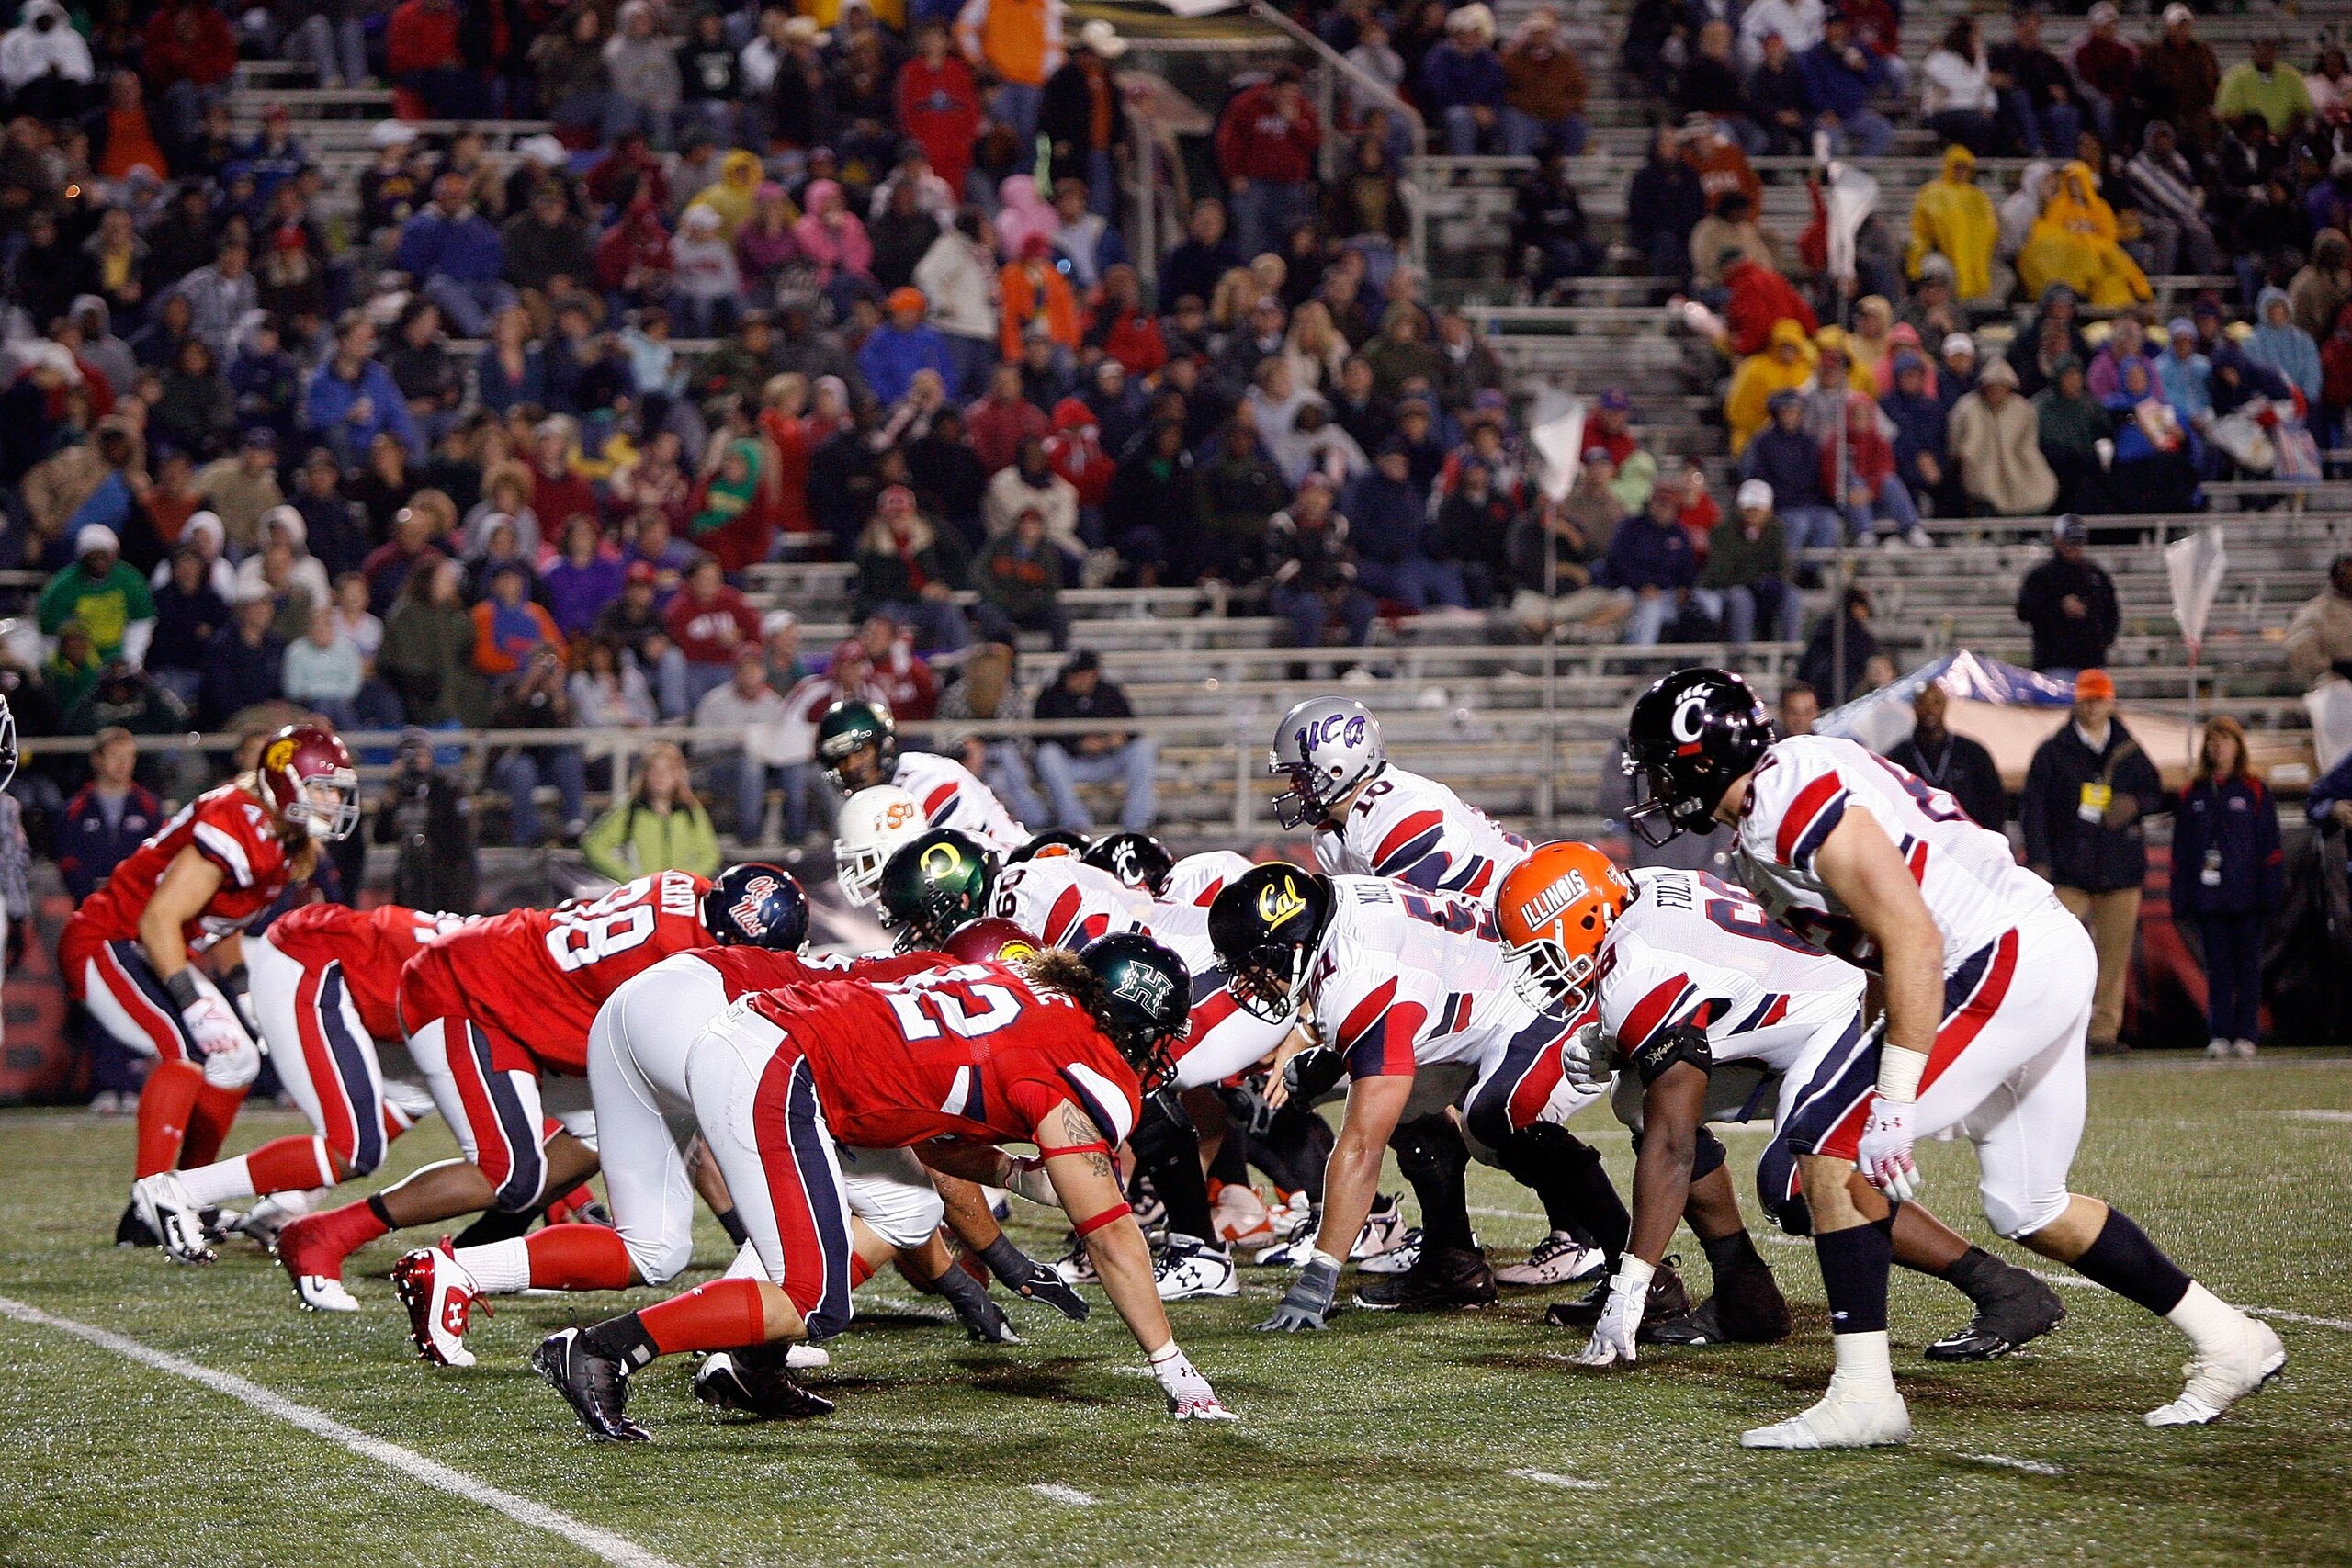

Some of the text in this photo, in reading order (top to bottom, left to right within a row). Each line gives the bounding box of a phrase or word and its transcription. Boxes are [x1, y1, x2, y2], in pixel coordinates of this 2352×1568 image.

[1672, 697, 1706, 743] C
[1352, 780, 1395, 818] 10
[919, 842, 962, 879] O
[745, 875, 779, 901] Ole
[1258, 874, 1307, 932] Cal
[1520, 867, 1589, 928] ILLINOIS
[729, 895, 763, 937] Miss
[1112, 960, 1174, 1020] H
